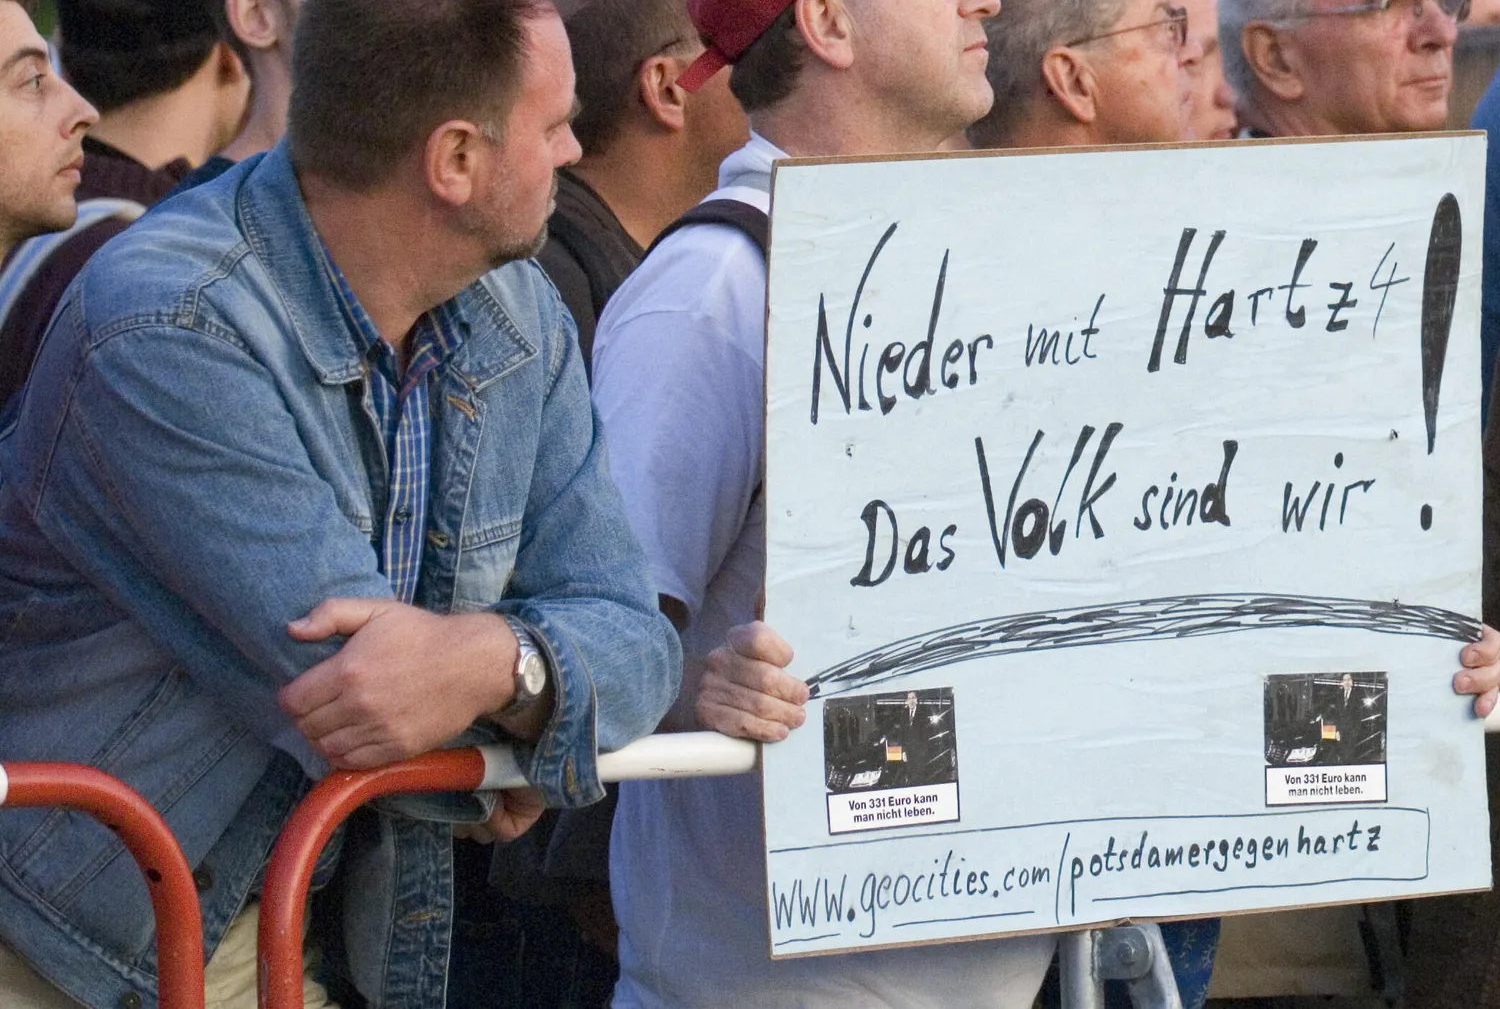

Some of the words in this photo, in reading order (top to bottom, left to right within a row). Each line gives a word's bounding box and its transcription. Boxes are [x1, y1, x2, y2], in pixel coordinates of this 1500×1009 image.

[810, 222, 994, 425] Nieder
[1025, 293, 1106, 368] mit
[849, 499, 957, 588] Das
[974, 422, 1125, 569] Volk
[1133, 439, 1240, 532] sind
[1284, 773, 1302, 785] Von
[1303, 773, 1319, 785] 331
[1321, 772, 1343, 784] Euro
[1344, 772, 1367, 783] kann
[1288, 788, 1308, 797] man
[1310, 785, 1334, 796] nicht
[1335, 784, 1364, 795] leben.
[848, 800, 867, 811] Von
[868, 797, 886, 810] 331
[888, 795, 912, 807] Euro
[913, 793, 938, 804] kann
[853, 812, 875, 823] man
[876, 808, 902, 820] nicht
[904, 805, 935, 818] leben.
